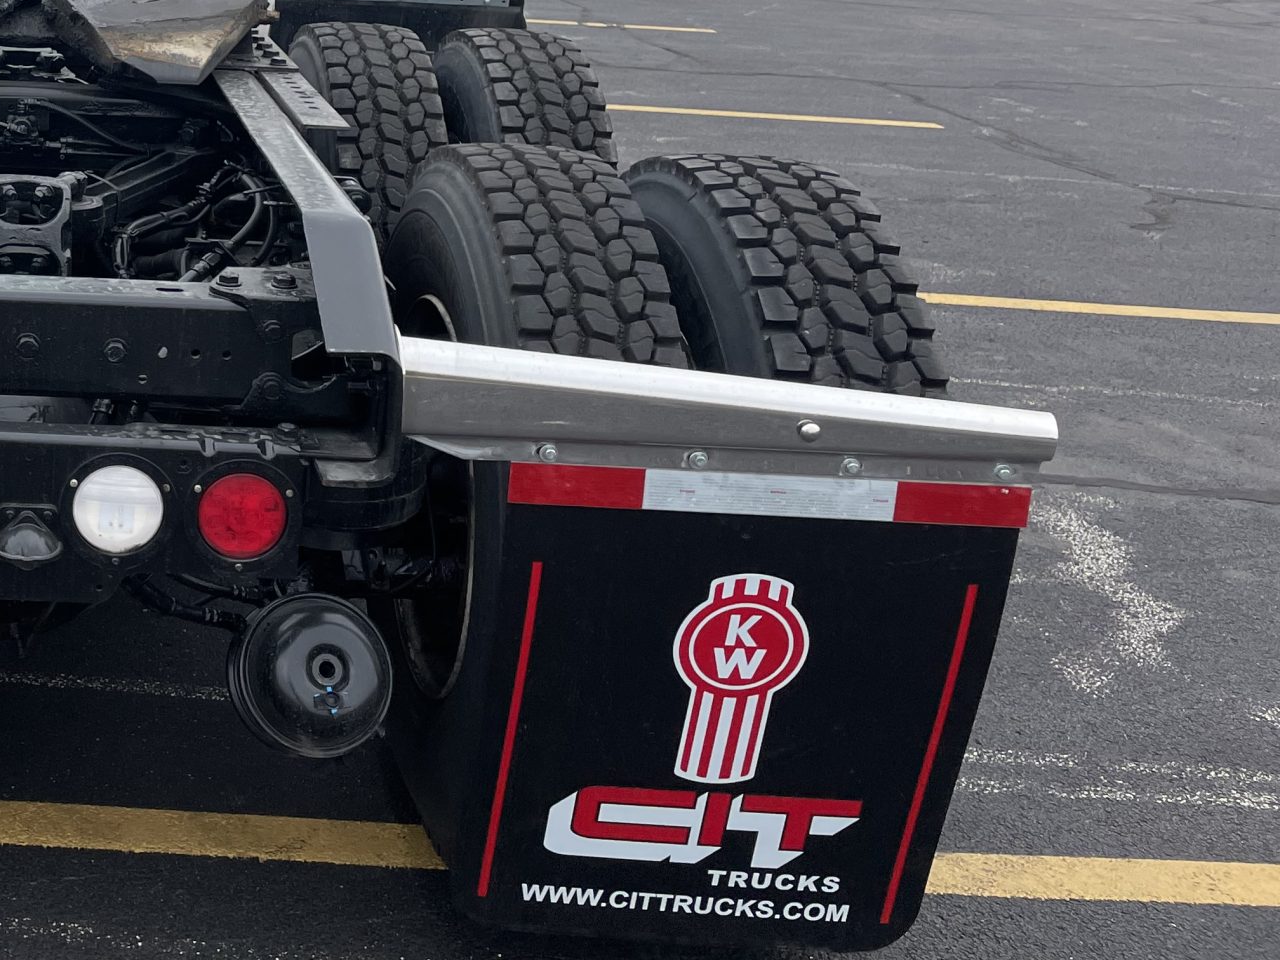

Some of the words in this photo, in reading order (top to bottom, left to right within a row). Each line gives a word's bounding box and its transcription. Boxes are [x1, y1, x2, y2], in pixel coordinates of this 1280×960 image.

[543, 785, 863, 869] CIT
[708, 869, 841, 894] TRUCKS
[521, 882, 851, 923] WWW.CITTRUCKS.COM
